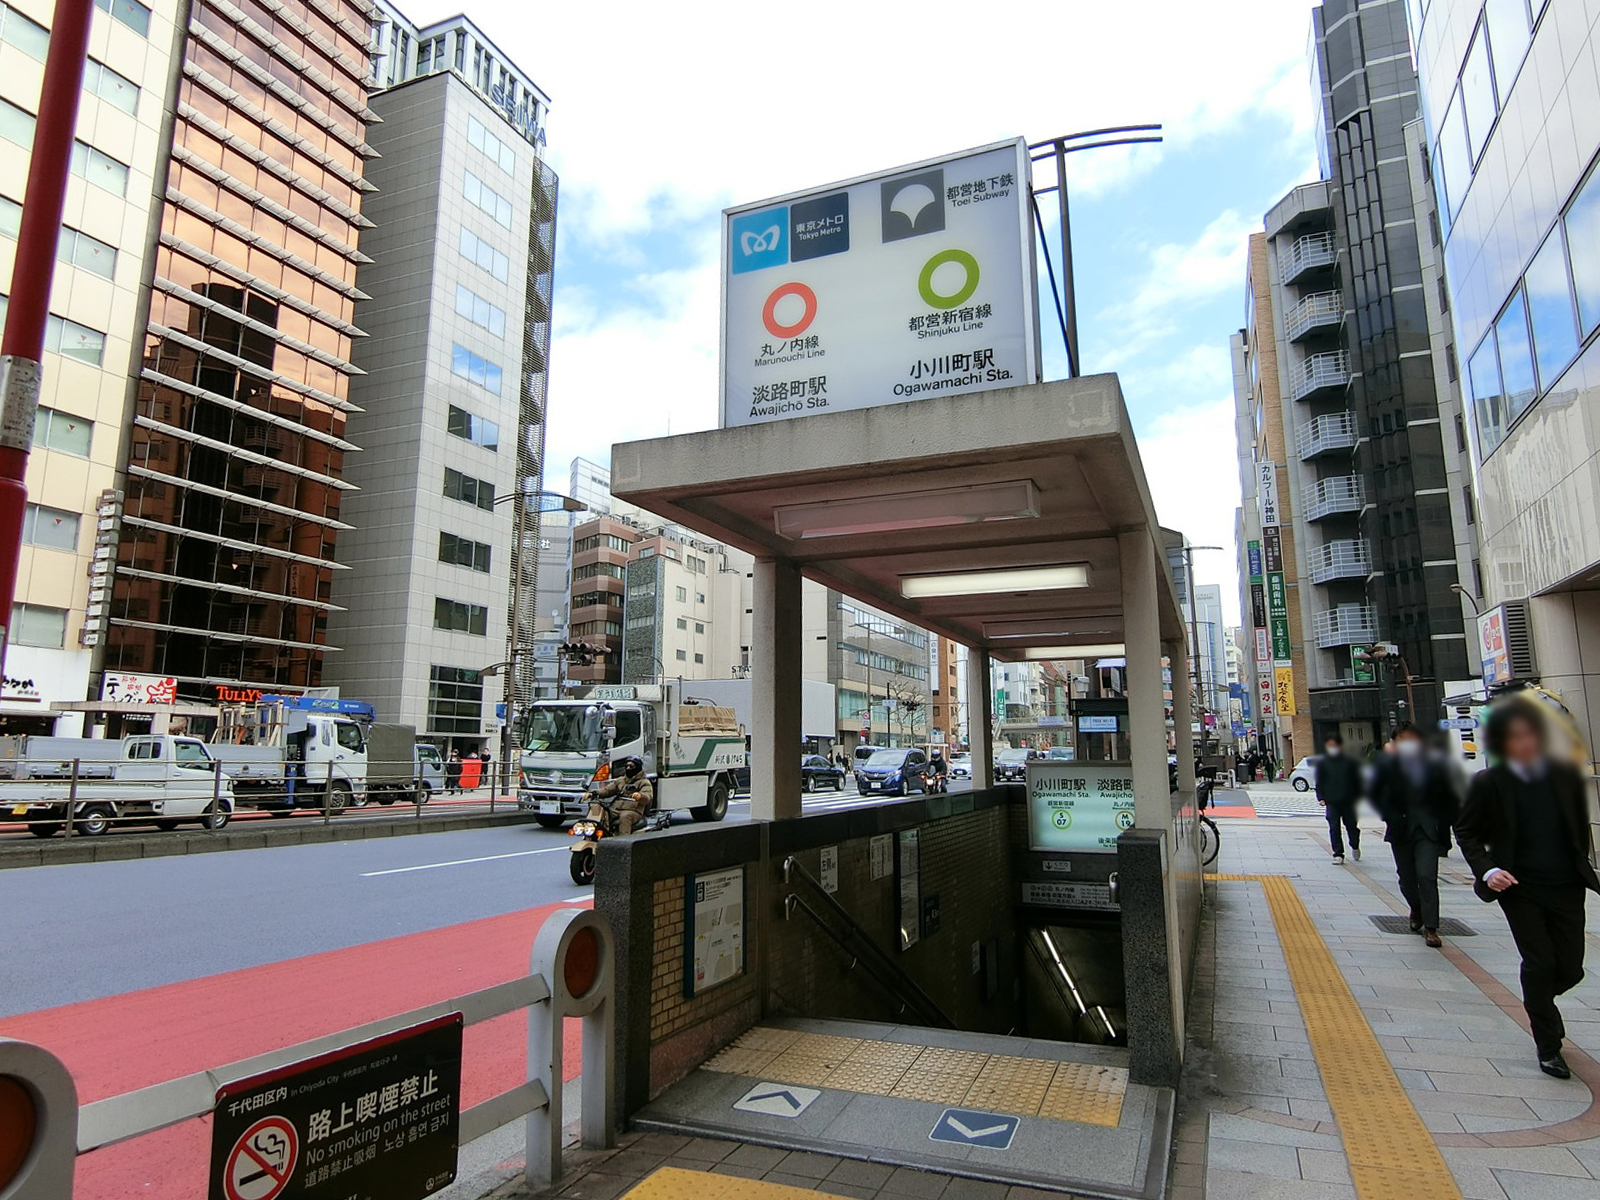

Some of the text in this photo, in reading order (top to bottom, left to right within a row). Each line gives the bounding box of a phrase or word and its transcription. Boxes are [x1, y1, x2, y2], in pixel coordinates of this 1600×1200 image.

[947, 173, 1014, 200] 都営地下鉄
[951, 188, 1010, 208] Toei Subway
[796, 214, 844, 234] 東京メトロ
[799, 226, 841, 241] Tokyo Metro
[909, 303, 992, 331] 都営新宿線
[918, 320, 983, 340] Shinjuku Line
[754, 348, 825, 366] Marunouchi Line
[761, 335, 819, 357] 丸ノ内線
[910, 349, 994, 379] 小川町駅
[752, 376, 827, 404] 淡路町駅
[893, 368, 1013, 396] Ogawamachi Sta.
[749, 396, 830, 417] Awajichō Sta.
[1260, 465, 1275, 523] カルフール神田
[1036, 778, 1086, 791] 小川町駅
[228, 1086, 288, 1117] 千代田区内
[299, 1078, 326, 1096] Chiyoda
[327, 1074, 340, 1086] City
[306, 1069, 439, 1144] 路上喫煙禁止
[306, 1094, 451, 1166] No smoking on the street
[304, 1112, 450, 1189] 道路禁止吸烟 노상 흡연 금지
